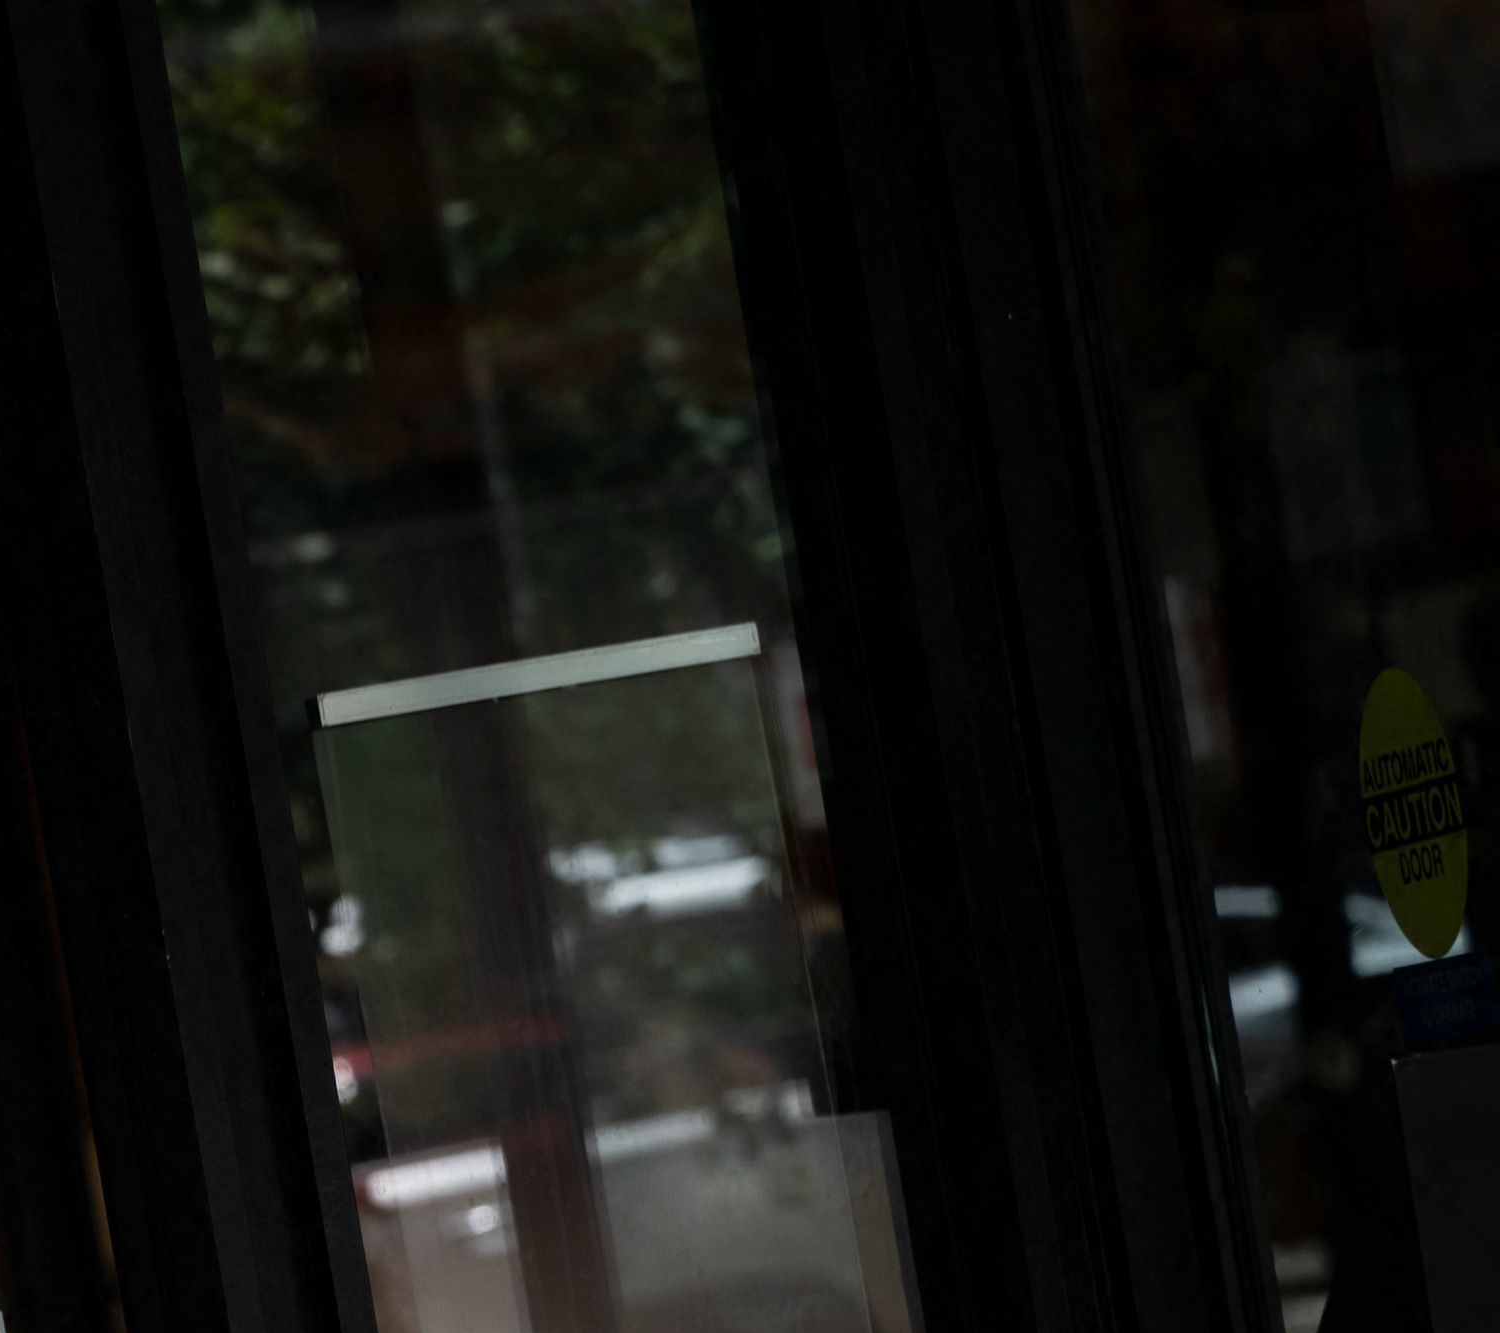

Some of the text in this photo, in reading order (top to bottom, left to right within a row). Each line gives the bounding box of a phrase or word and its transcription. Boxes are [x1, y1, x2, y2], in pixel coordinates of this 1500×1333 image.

[1363, 737, 1449, 792] AUTOMATIC
[1366, 781, 1464, 849] CAUTION
[1400, 844, 1445, 885] DOOR
